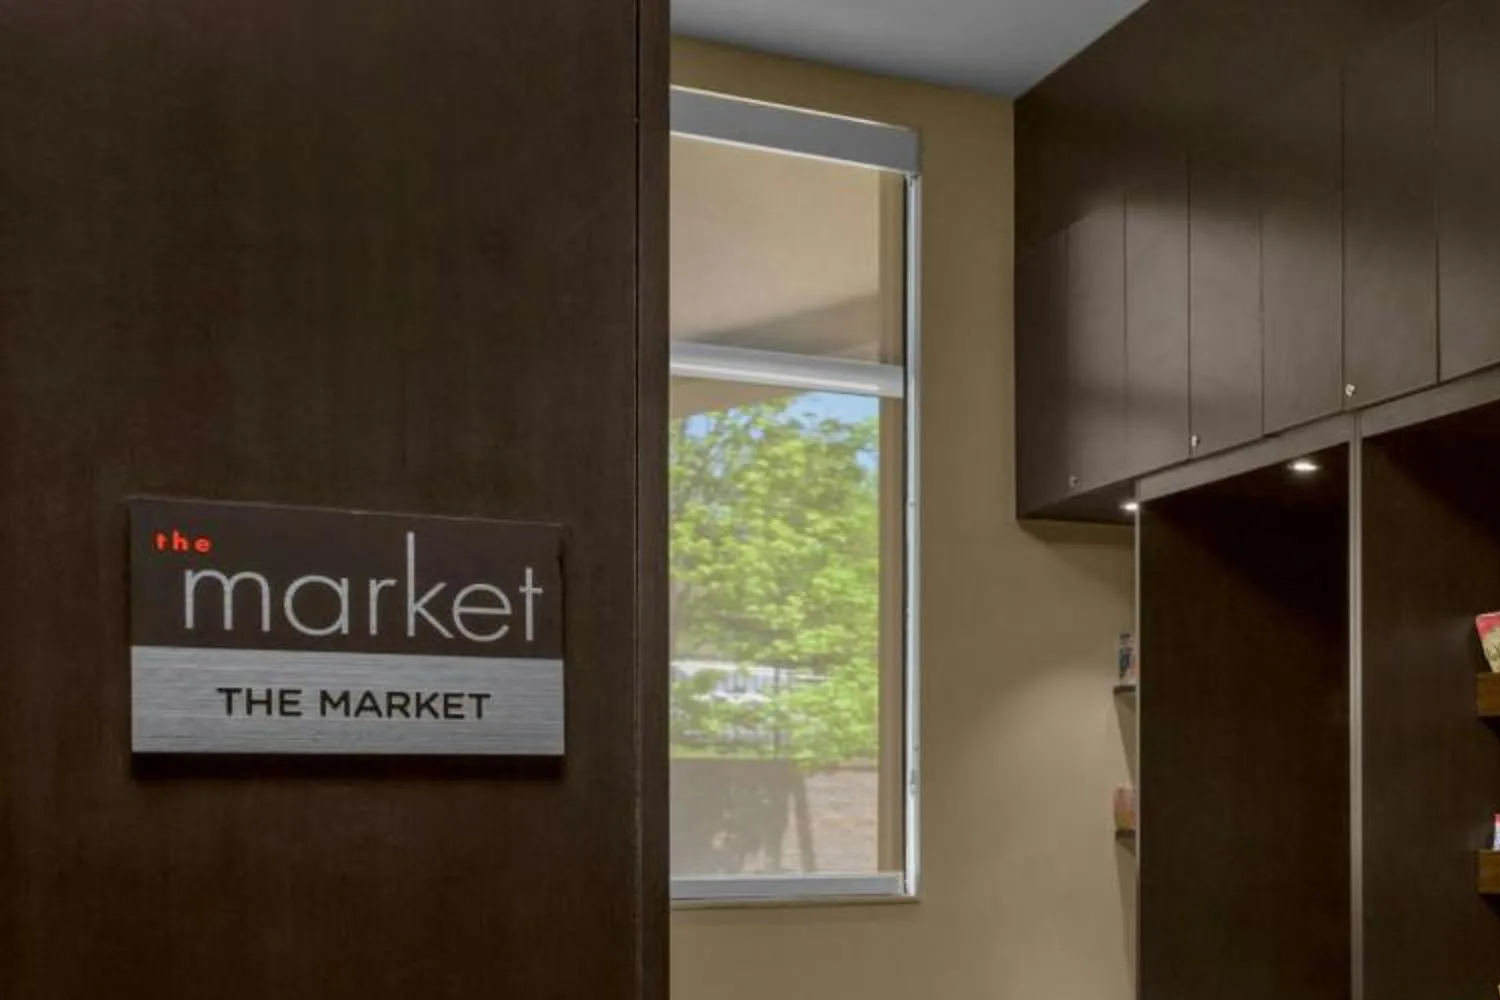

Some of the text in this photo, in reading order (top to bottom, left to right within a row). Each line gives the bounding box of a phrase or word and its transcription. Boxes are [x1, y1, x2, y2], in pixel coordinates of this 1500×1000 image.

[154, 531, 213, 553] the
[183, 531, 544, 642] market
[217, 688, 491, 719] THE MARKET
